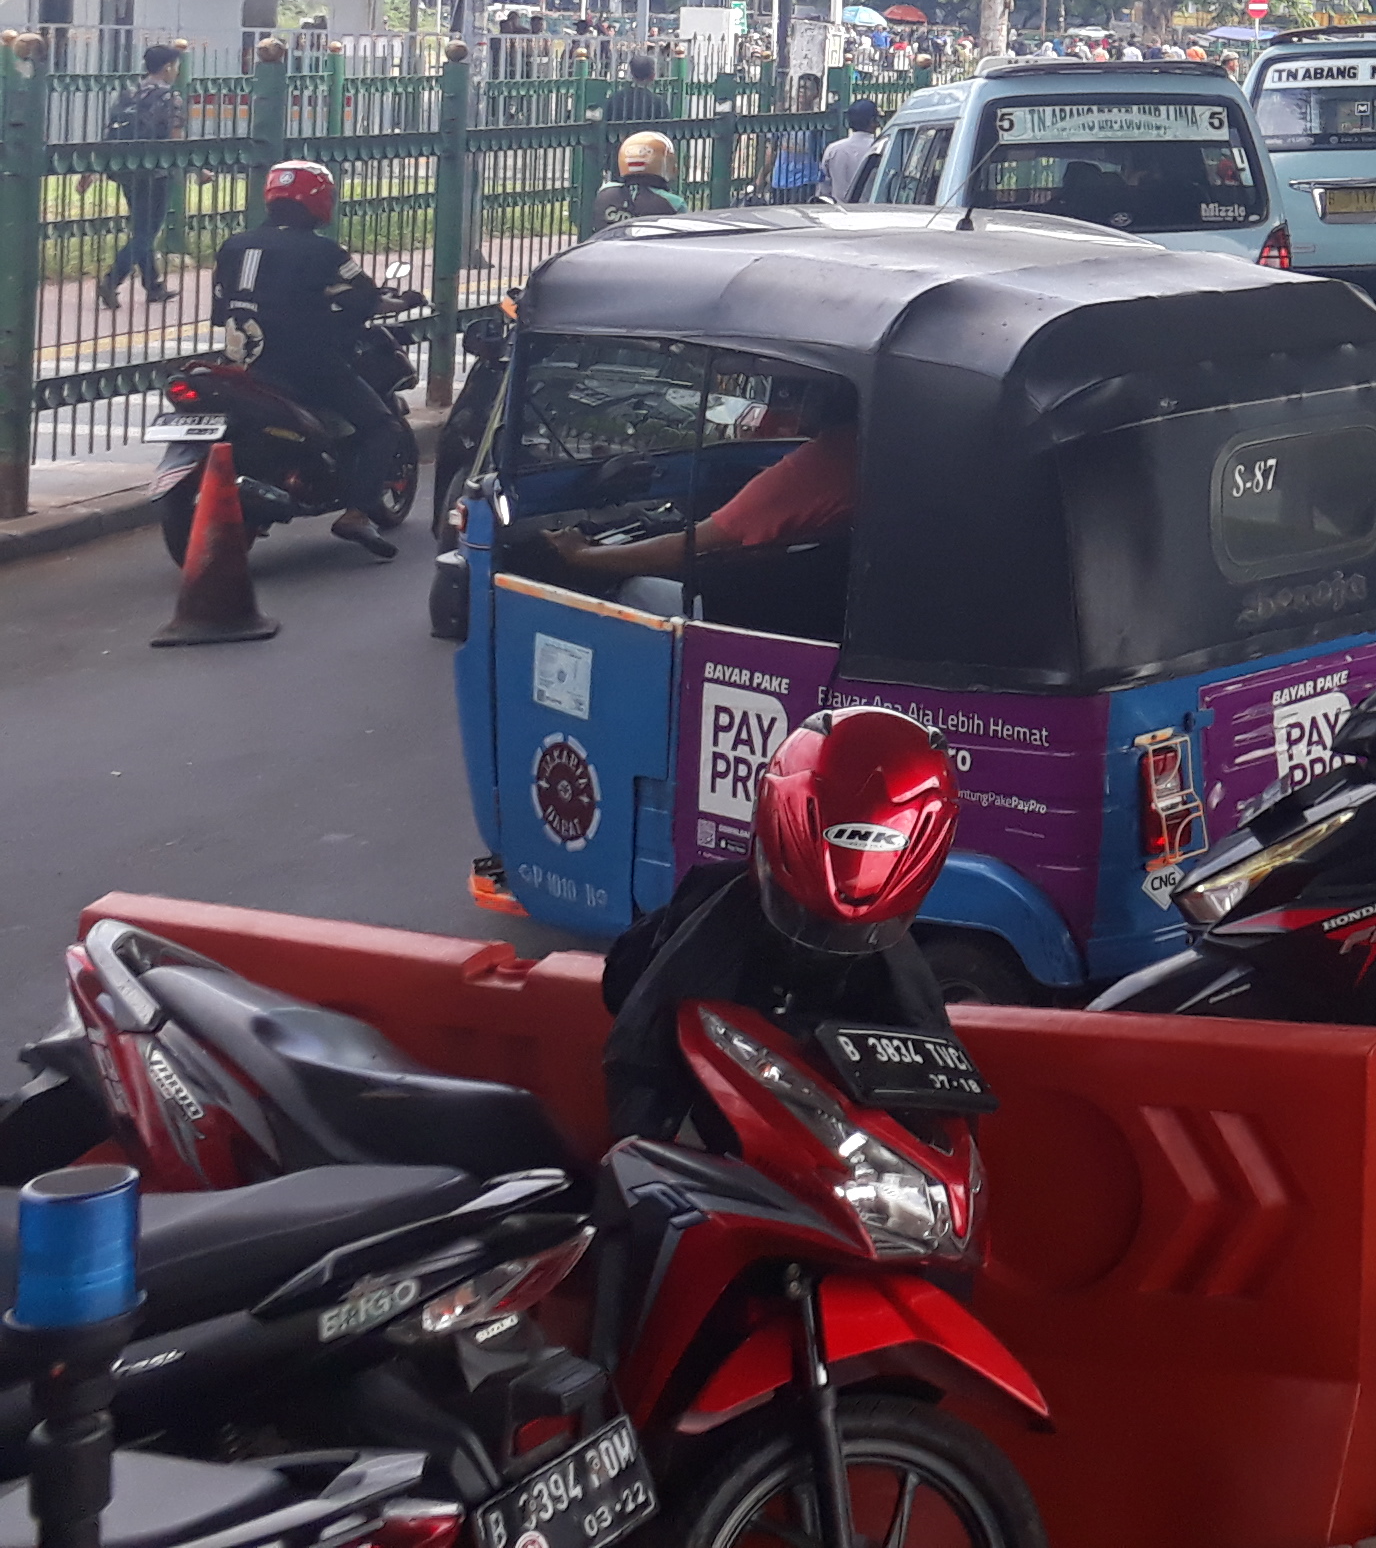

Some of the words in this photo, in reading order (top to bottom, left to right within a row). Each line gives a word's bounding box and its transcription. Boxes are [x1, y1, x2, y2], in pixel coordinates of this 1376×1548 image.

[998, 112, 1015, 133] 5
[1208, 111, 1225, 131] 5
[1232, 458, 1278, 498] S-87
[704, 661, 750, 687] BAYAR
[753, 673, 790, 695] PAKE
[1271, 680, 1315, 706] BAYAR
[1316, 670, 1349, 693] PAKE
[712, 704, 778, 758] PAY
[939, 708, 984, 735] Lebih
[989, 717, 1050, 747] Hemat
[1285, 708, 1343, 761] PAY
[957, 789, 1047, 814] ntungPakePayPro
[832, 828, 899, 845] INK
[1150, 870, 1177, 892] CNG
[836, 1034, 861, 1062] B
[867, 1036, 924, 1064] 3834
